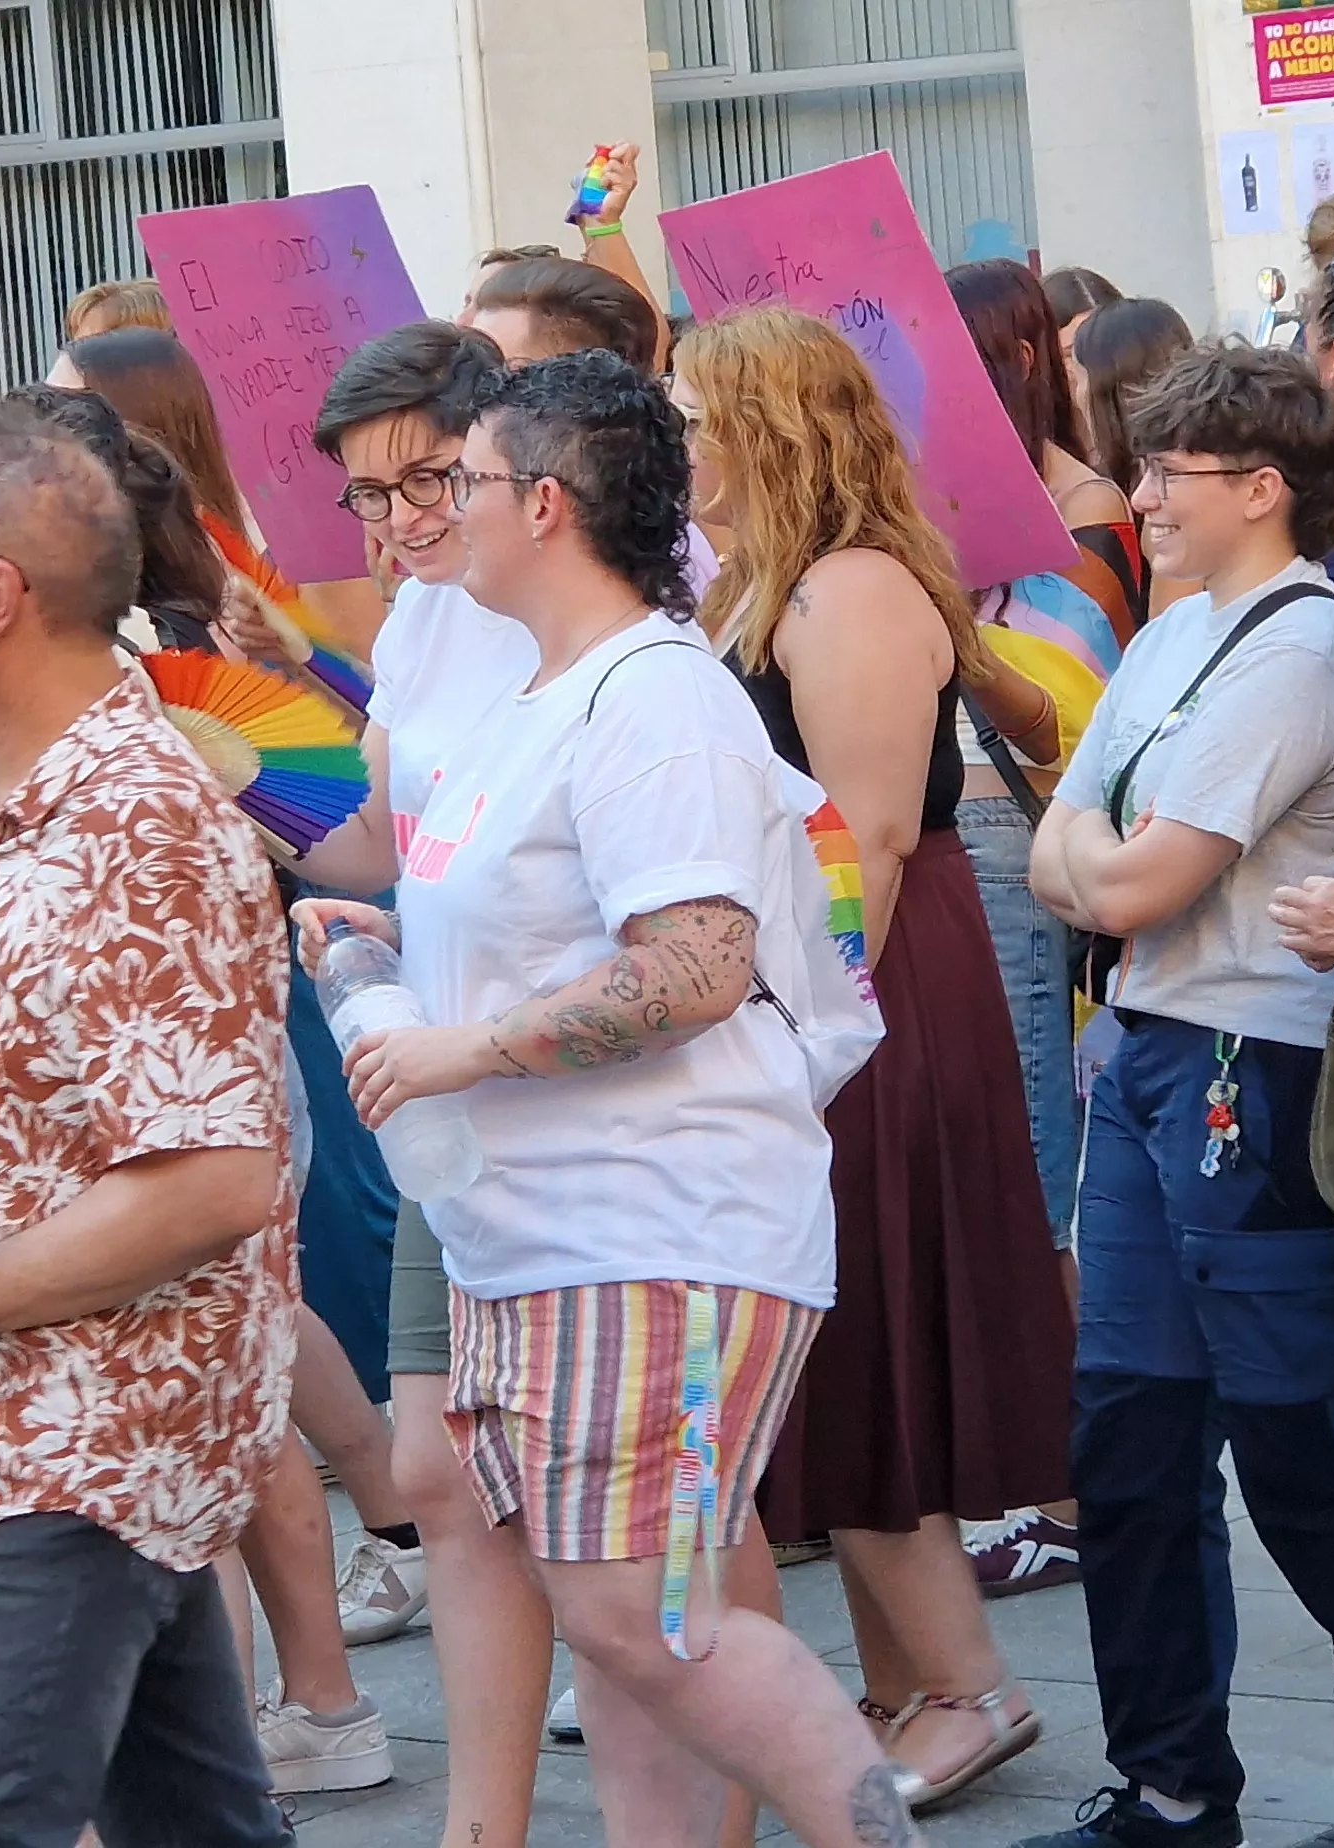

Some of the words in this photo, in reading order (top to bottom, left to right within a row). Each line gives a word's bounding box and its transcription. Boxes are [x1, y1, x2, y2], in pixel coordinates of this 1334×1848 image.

[1264, 24, 1283, 39] YO
[1284, 22, 1302, 36] NO
[1269, 61, 1283, 79] A
[259, 235, 331, 283] ODIO
[194, 314, 267, 362] NUNCA
[343, 295, 366, 325] A
[219, 356, 304, 419] NADIE
